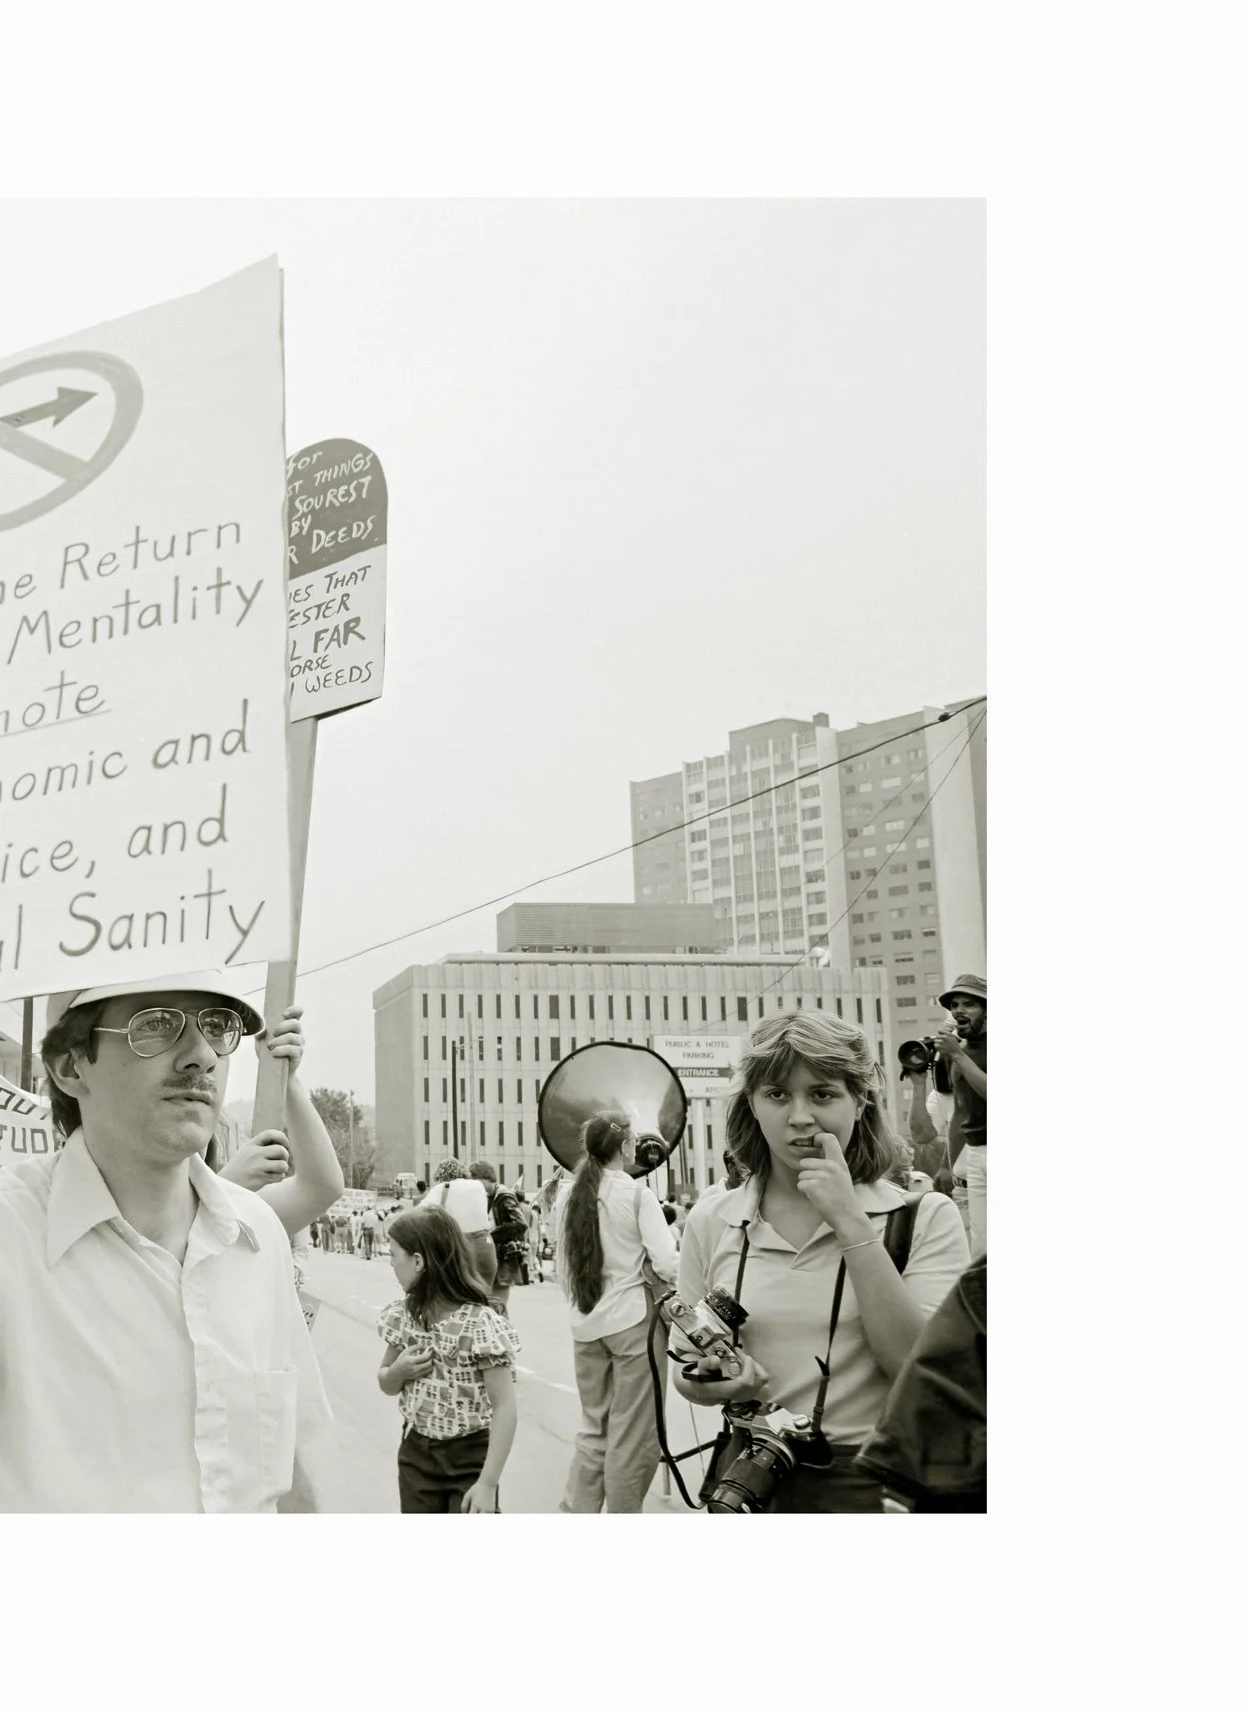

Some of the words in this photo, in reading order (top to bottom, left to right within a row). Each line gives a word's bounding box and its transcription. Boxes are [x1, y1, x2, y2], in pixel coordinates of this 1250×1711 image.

[314, 452, 373, 487] THINGS
[291, 475, 372, 521] SOUREST
[290, 514, 311, 538] BY
[60, 522, 240, 589] Return
[324, 565, 371, 594] THAT
[7, 567, 264, 664] Mentality
[313, 616, 366, 653] FAR
[305, 661, 373, 693] WEEDS
[152, 698, 249, 769] and
[128, 782, 228, 858] and
[59, 868, 265, 965] Sanity
[678, 1068, 719, 1077] ENTRANCE
